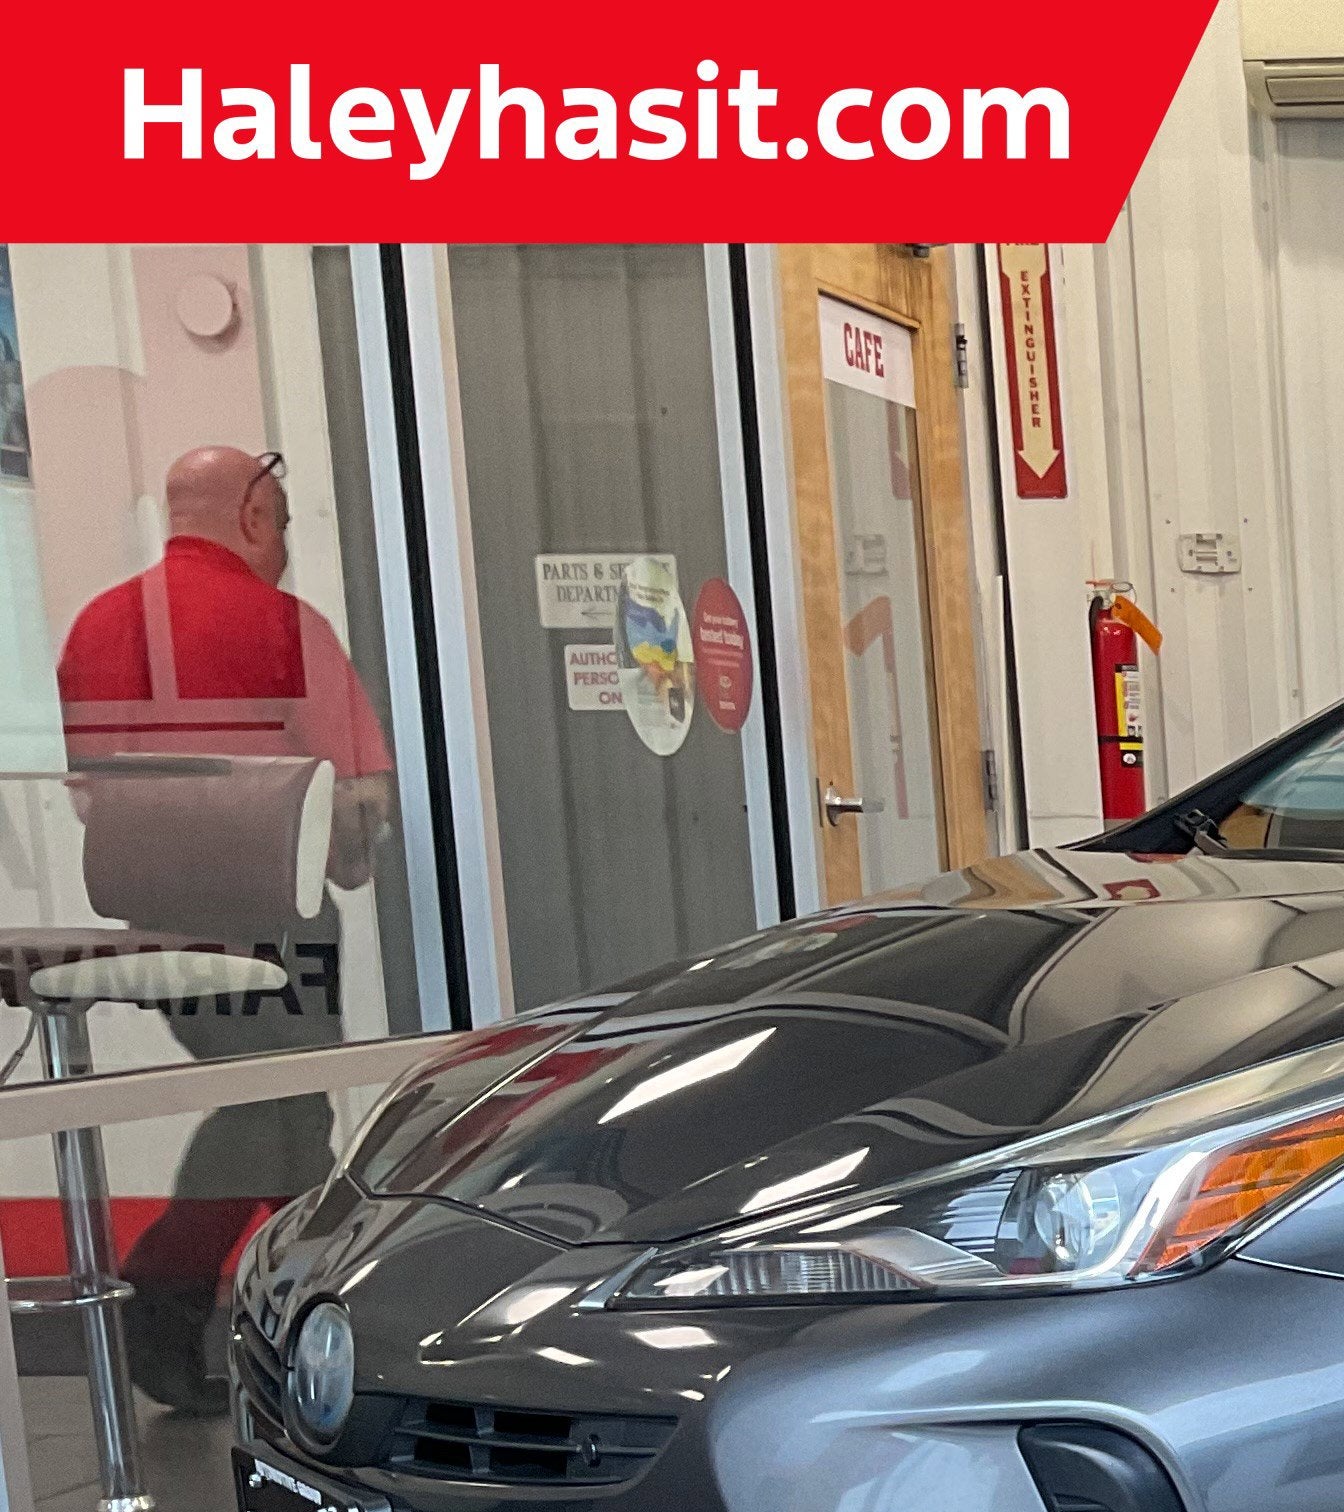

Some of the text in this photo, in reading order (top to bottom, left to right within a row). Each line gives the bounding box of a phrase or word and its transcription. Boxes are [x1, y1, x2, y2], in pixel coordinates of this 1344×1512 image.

[843, 322, 884, 378] CAFE
[1020, 270, 1041, 428] EXTINGUISHER
[542, 563, 588, 580] PARTS
[557, 585, 619, 602] DEPART
[574, 671, 619, 685] PERSO
